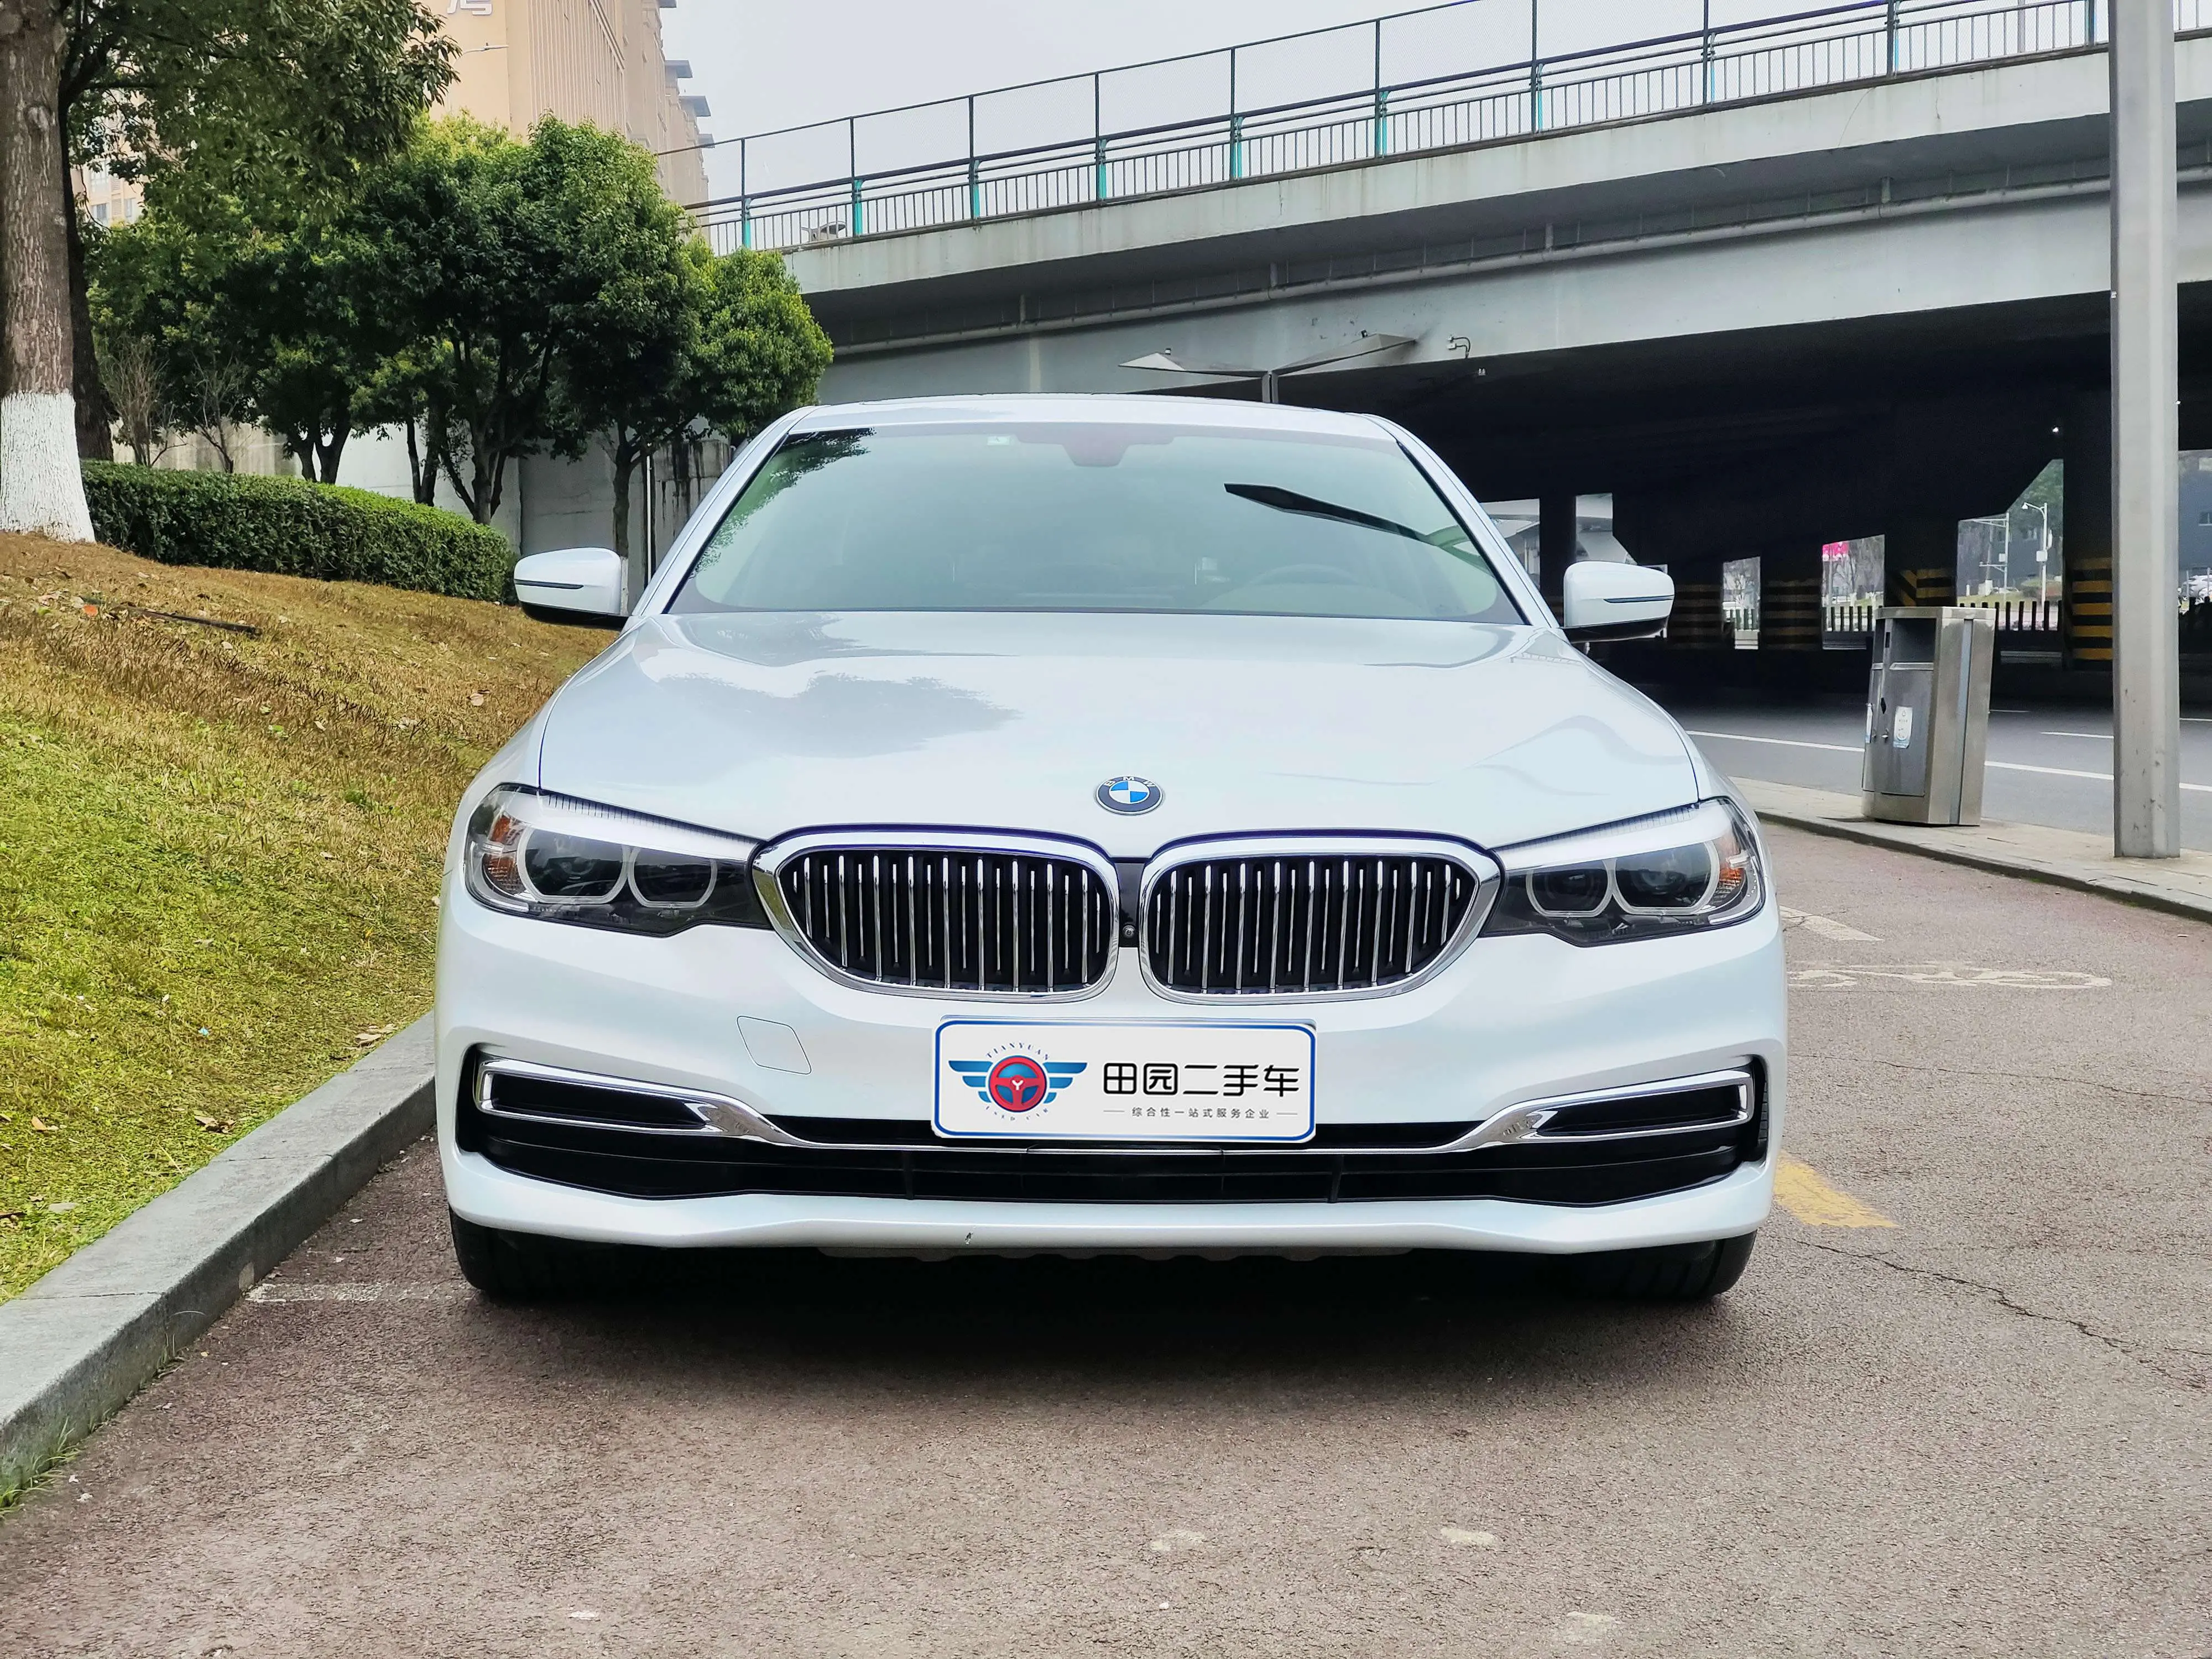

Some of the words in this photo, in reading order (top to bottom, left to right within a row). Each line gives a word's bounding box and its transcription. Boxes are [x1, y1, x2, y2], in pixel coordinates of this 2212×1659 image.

[1103, 776, 1157, 787] BMW
[1103, 1062, 1300, 1097] 田园二手车
[1131, 1107, 1270, 1119] 综合性一站式服务企业
